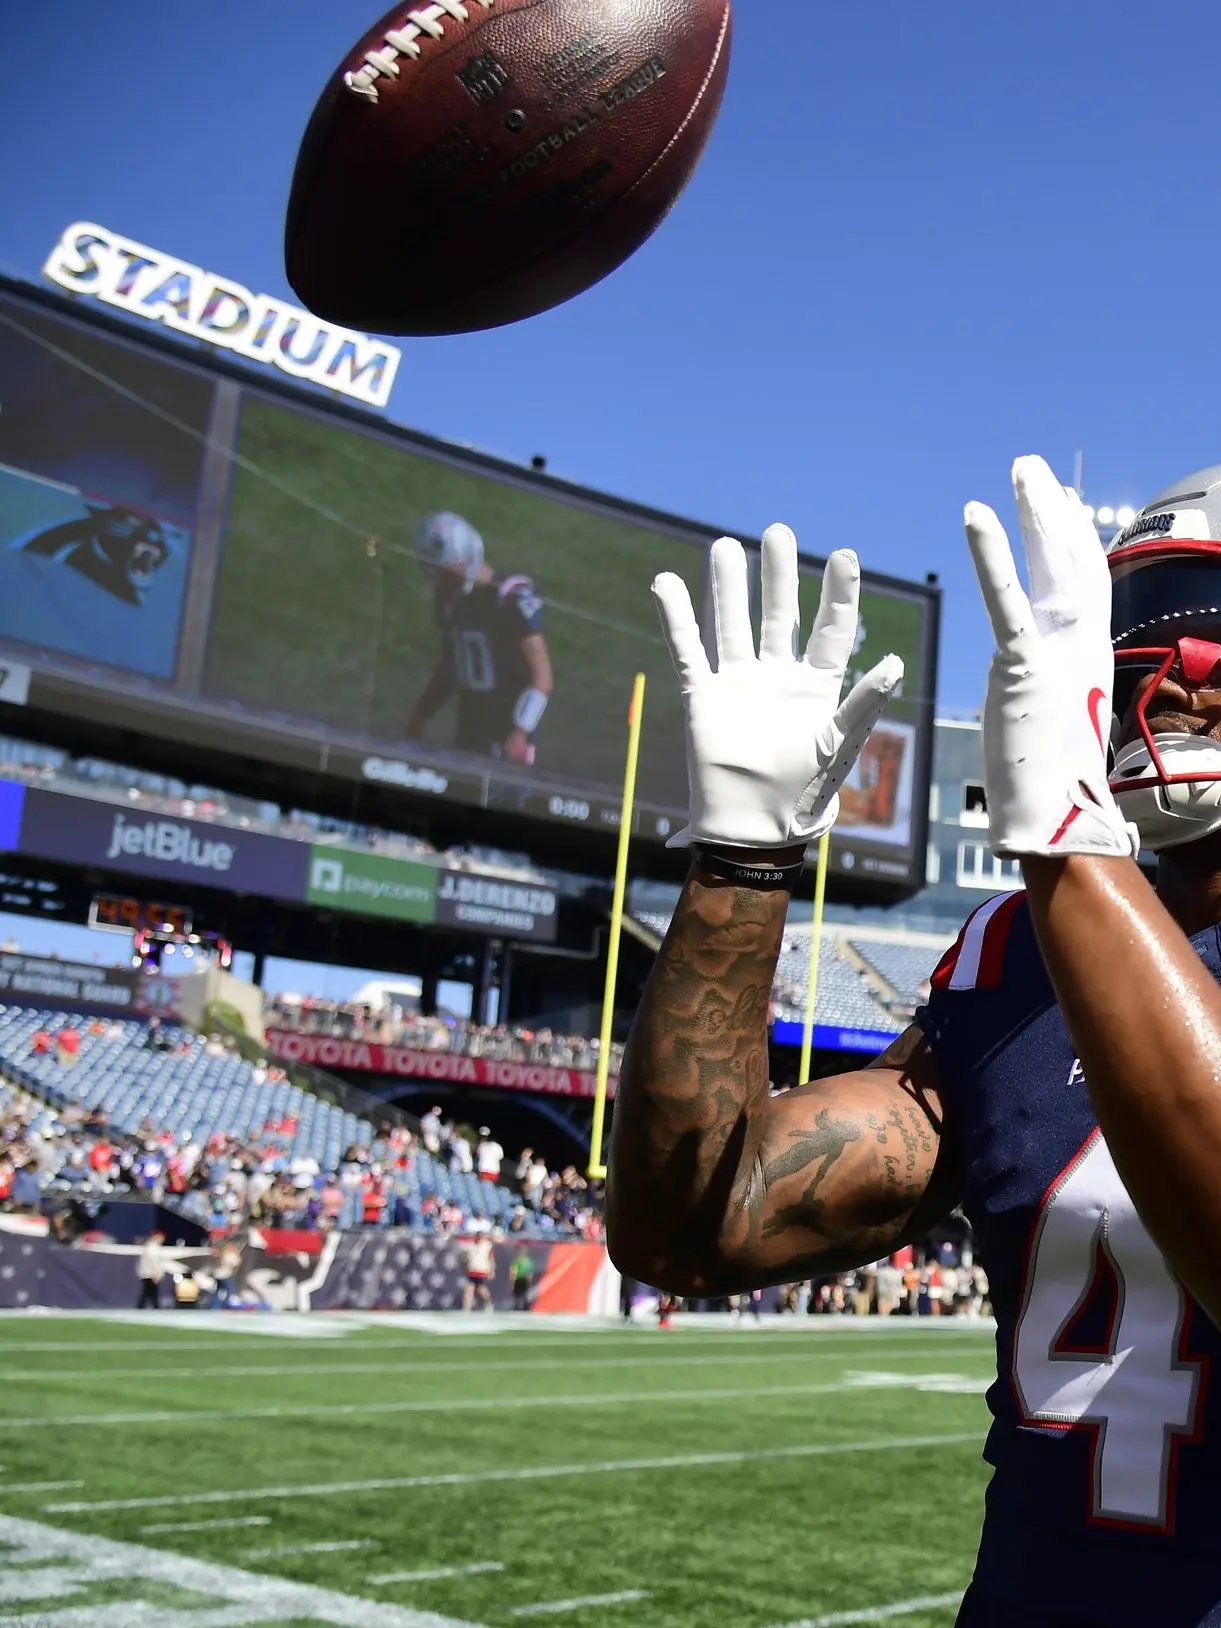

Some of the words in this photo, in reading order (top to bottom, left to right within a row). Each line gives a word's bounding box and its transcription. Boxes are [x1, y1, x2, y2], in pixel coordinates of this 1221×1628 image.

[499, 104, 600, 184] FOOTBALL
[604, 56, 667, 111] LEAGUE
[48, 225, 399, 403] STADIUM
[362, 756, 448, 794] Gillette
[106, 812, 235, 871] jetBlue
[343, 873, 430, 903] paycom
[732, 869, 762, 880] JOHN
[764, 871, 783, 881] 3:30
[269, 1032, 373, 1071] TOYOTA
[382, 1047, 478, 1083] TOYOTA
[485, 1060, 573, 1096] TOYOTA
[1013, 1125, 1210, 1537] 4
